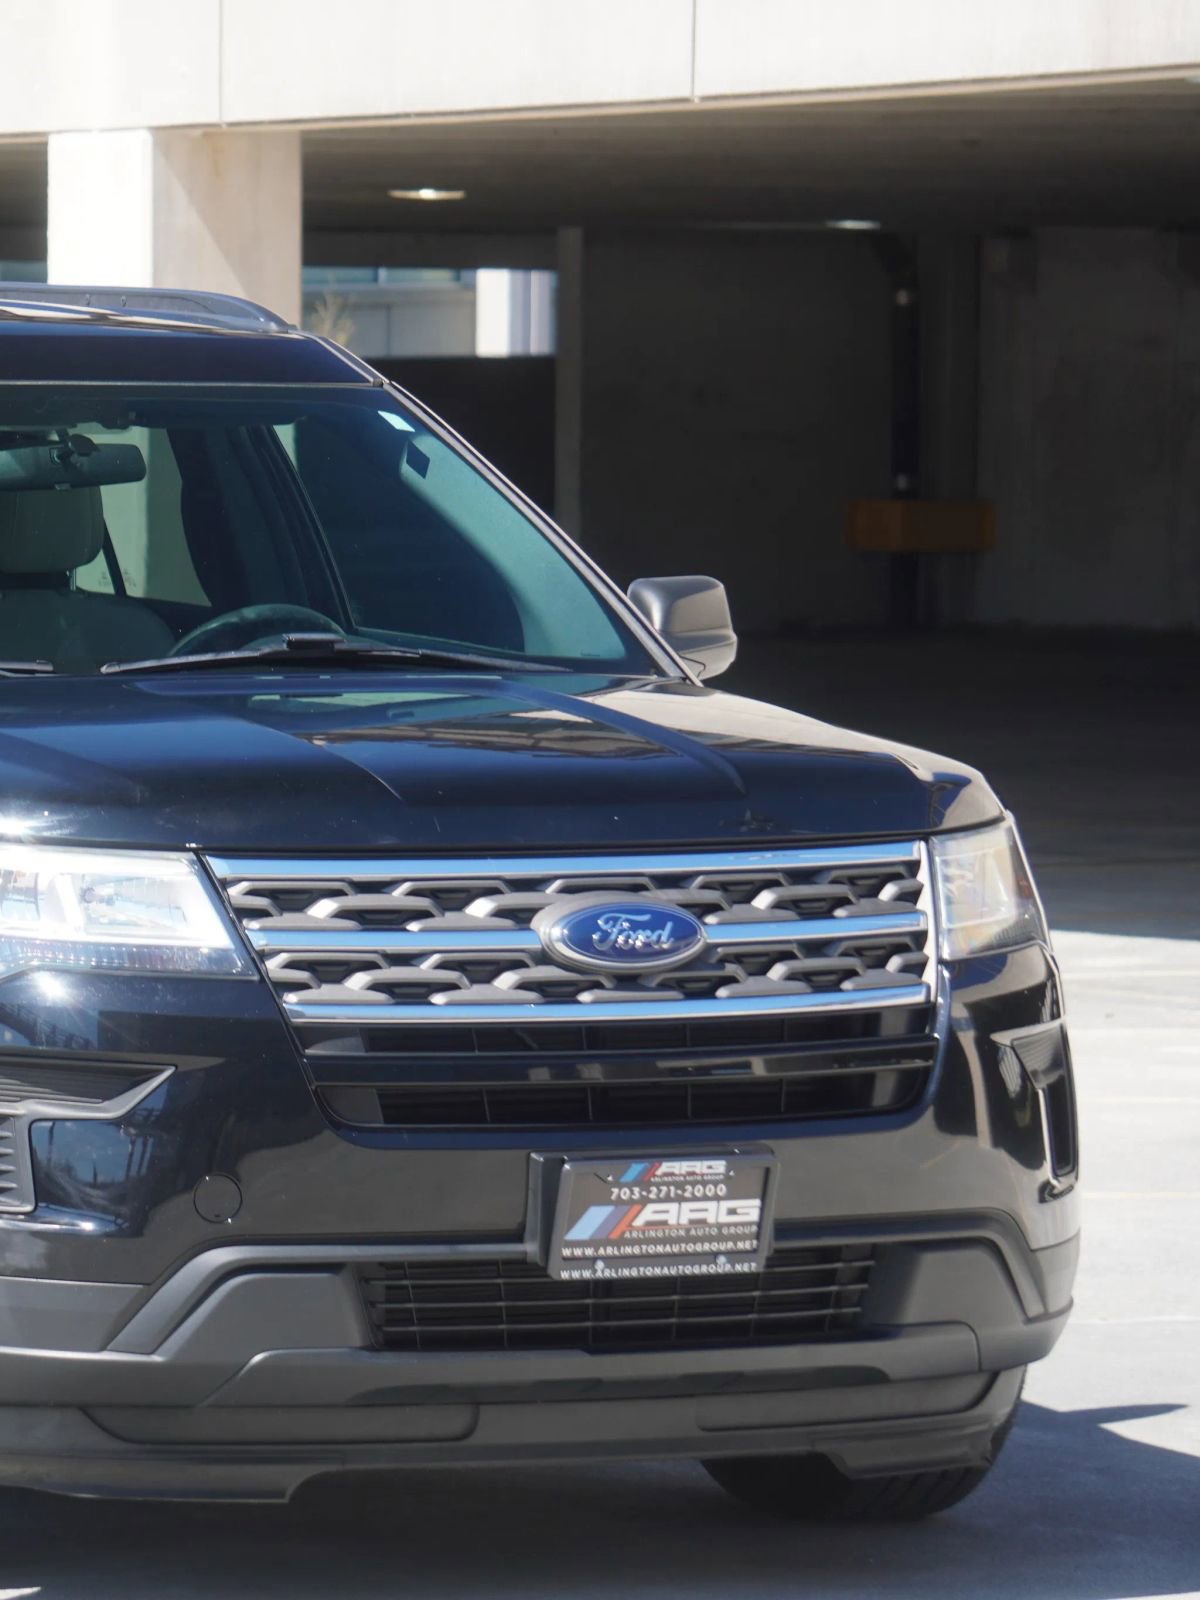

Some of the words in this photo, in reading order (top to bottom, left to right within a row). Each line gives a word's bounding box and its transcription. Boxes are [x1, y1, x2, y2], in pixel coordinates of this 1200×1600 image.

[592, 912, 675, 951] Ford
[655, 1160, 727, 1175] AAG
[610, 1183, 727, 1200] 703-271-2000
[631, 1198, 762, 1227] AAG
[623, 1228, 686, 1239] ARLINGTON
[689, 1226, 718, 1237] AUTO
[721, 1225, 758, 1236] GROUP
[561, 1240, 758, 1257] WWW.ARLINGTONAUTOGROUP.NET
[560, 1262, 757, 1280] WWW.ARLINGTONAUTOGROUP.NET
